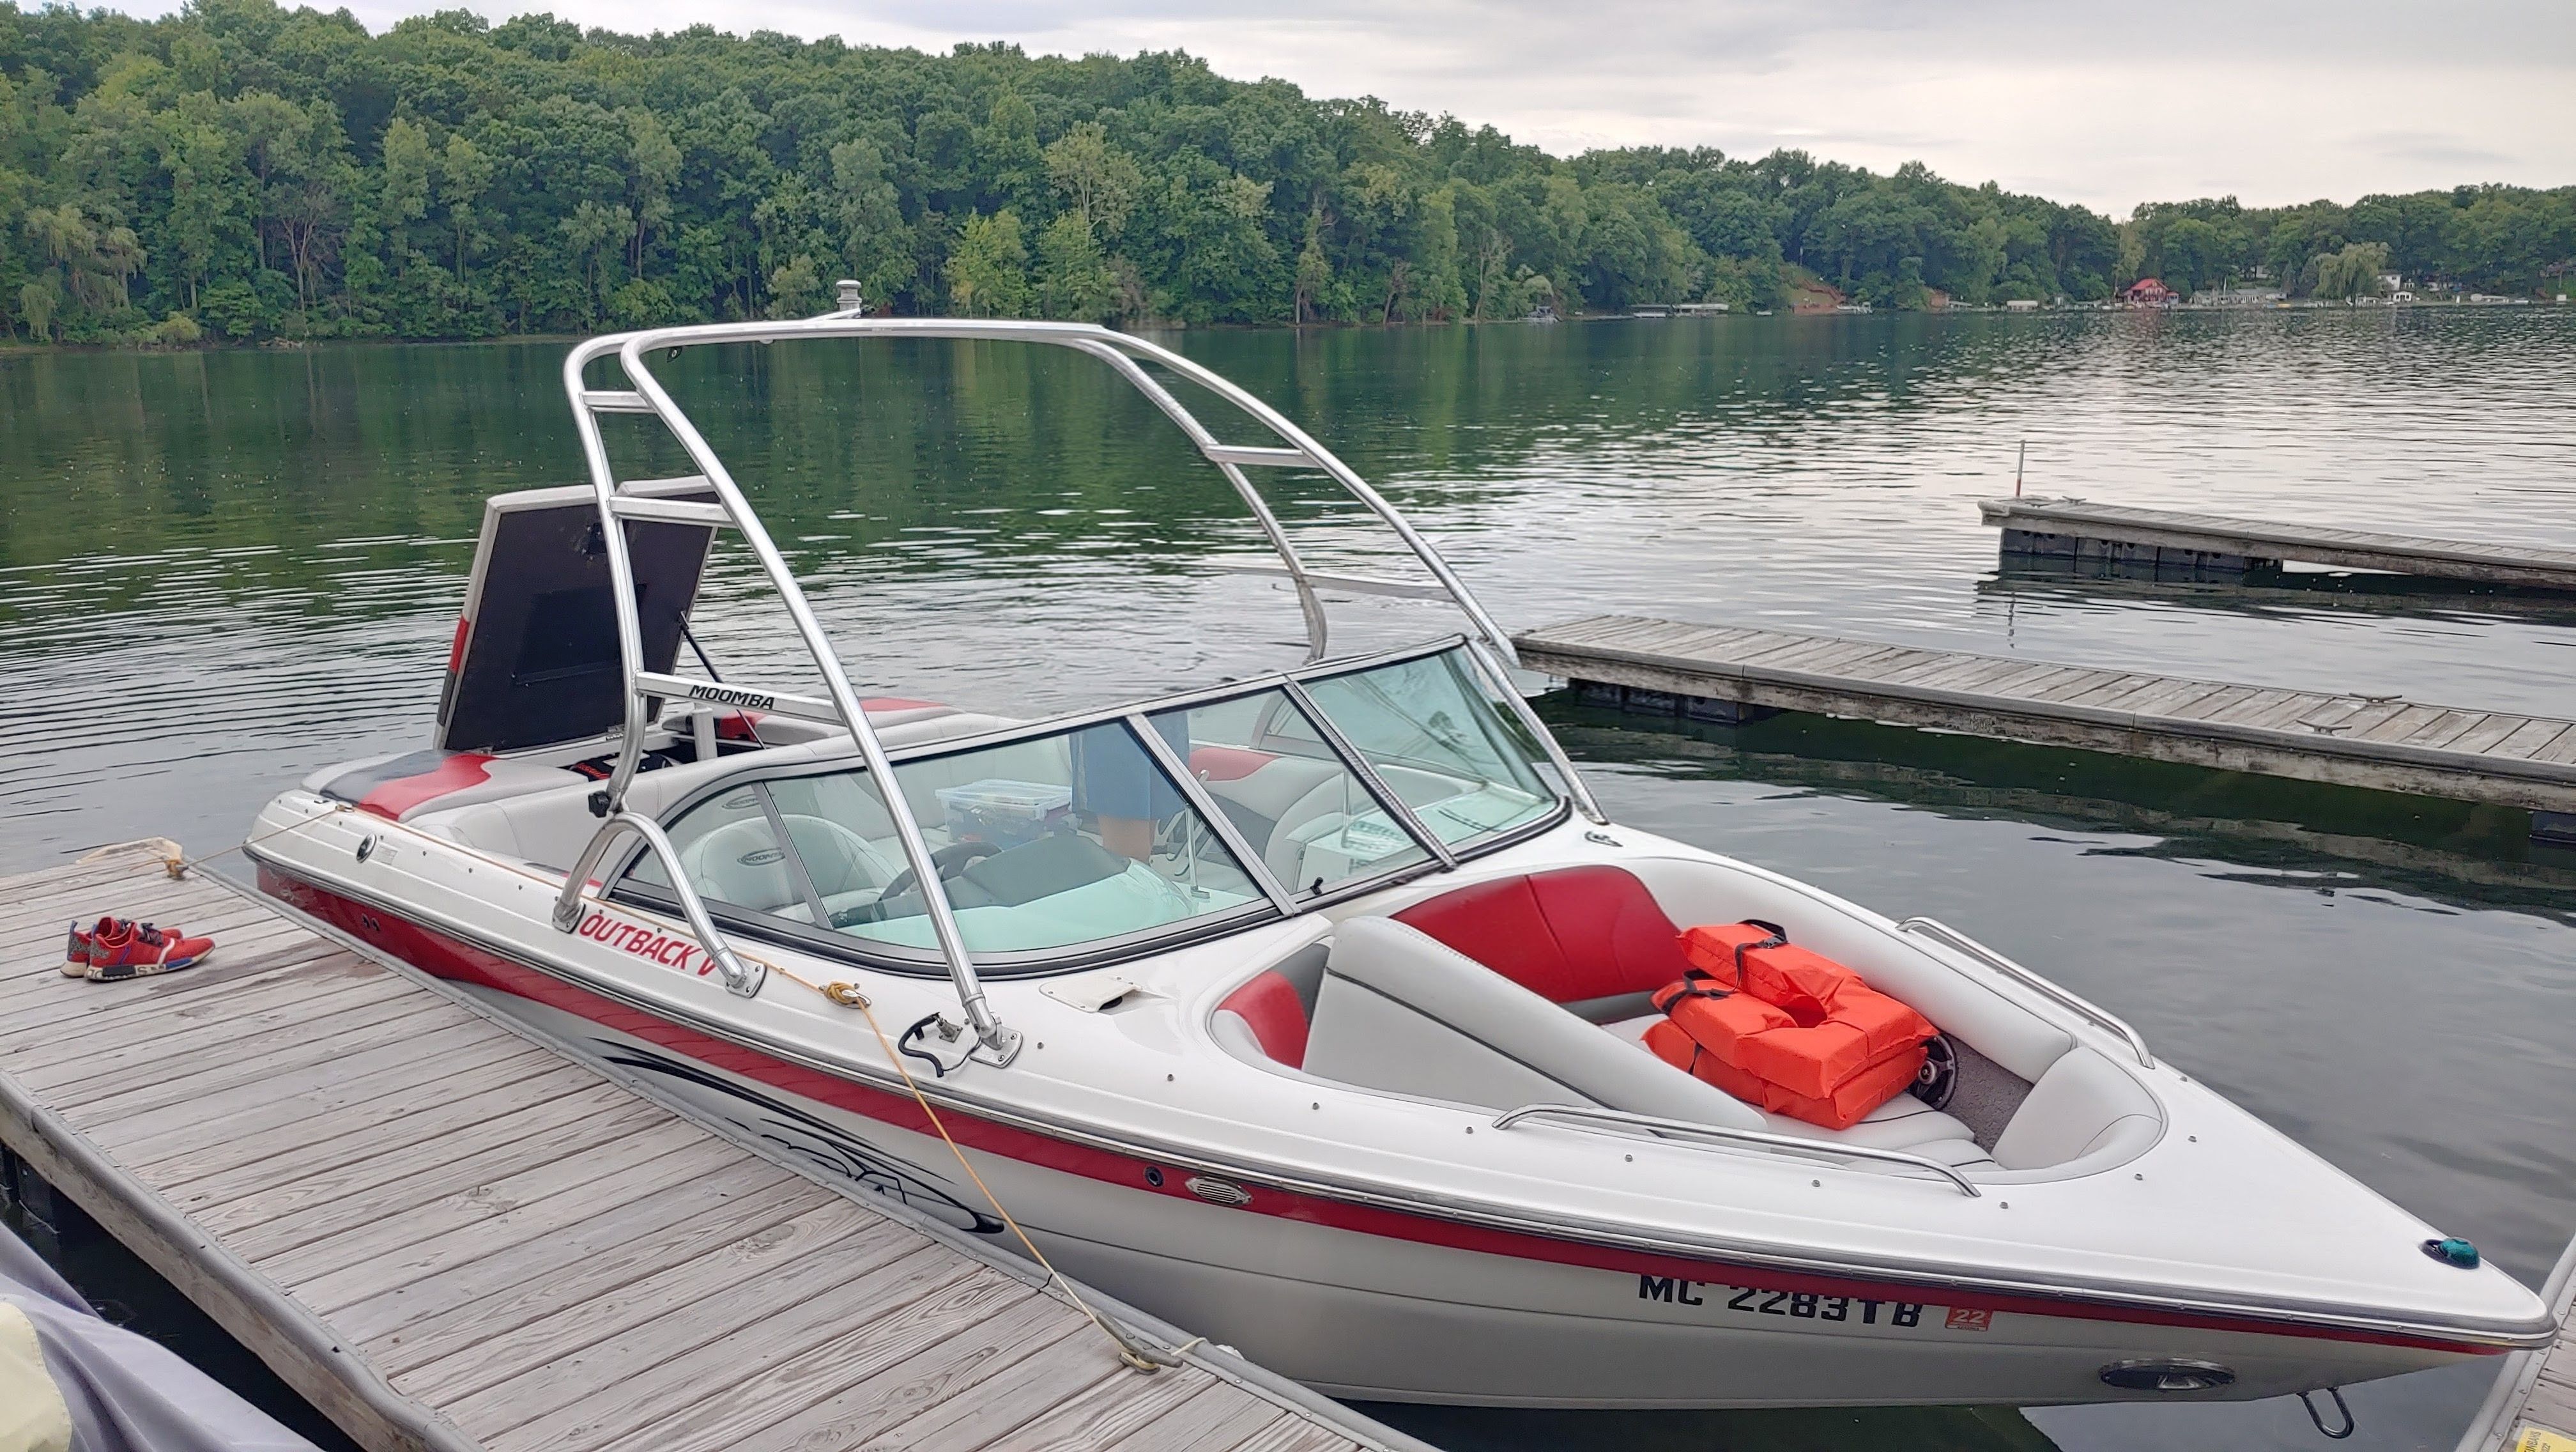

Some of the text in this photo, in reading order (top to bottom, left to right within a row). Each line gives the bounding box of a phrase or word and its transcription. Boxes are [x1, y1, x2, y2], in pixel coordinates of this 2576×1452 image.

[688, 684, 775, 710] MOOMBA
[579, 914, 703, 970] OUTBACK
[1639, 1274, 1705, 1306] MC
[1953, 1308, 1986, 1324] 22
